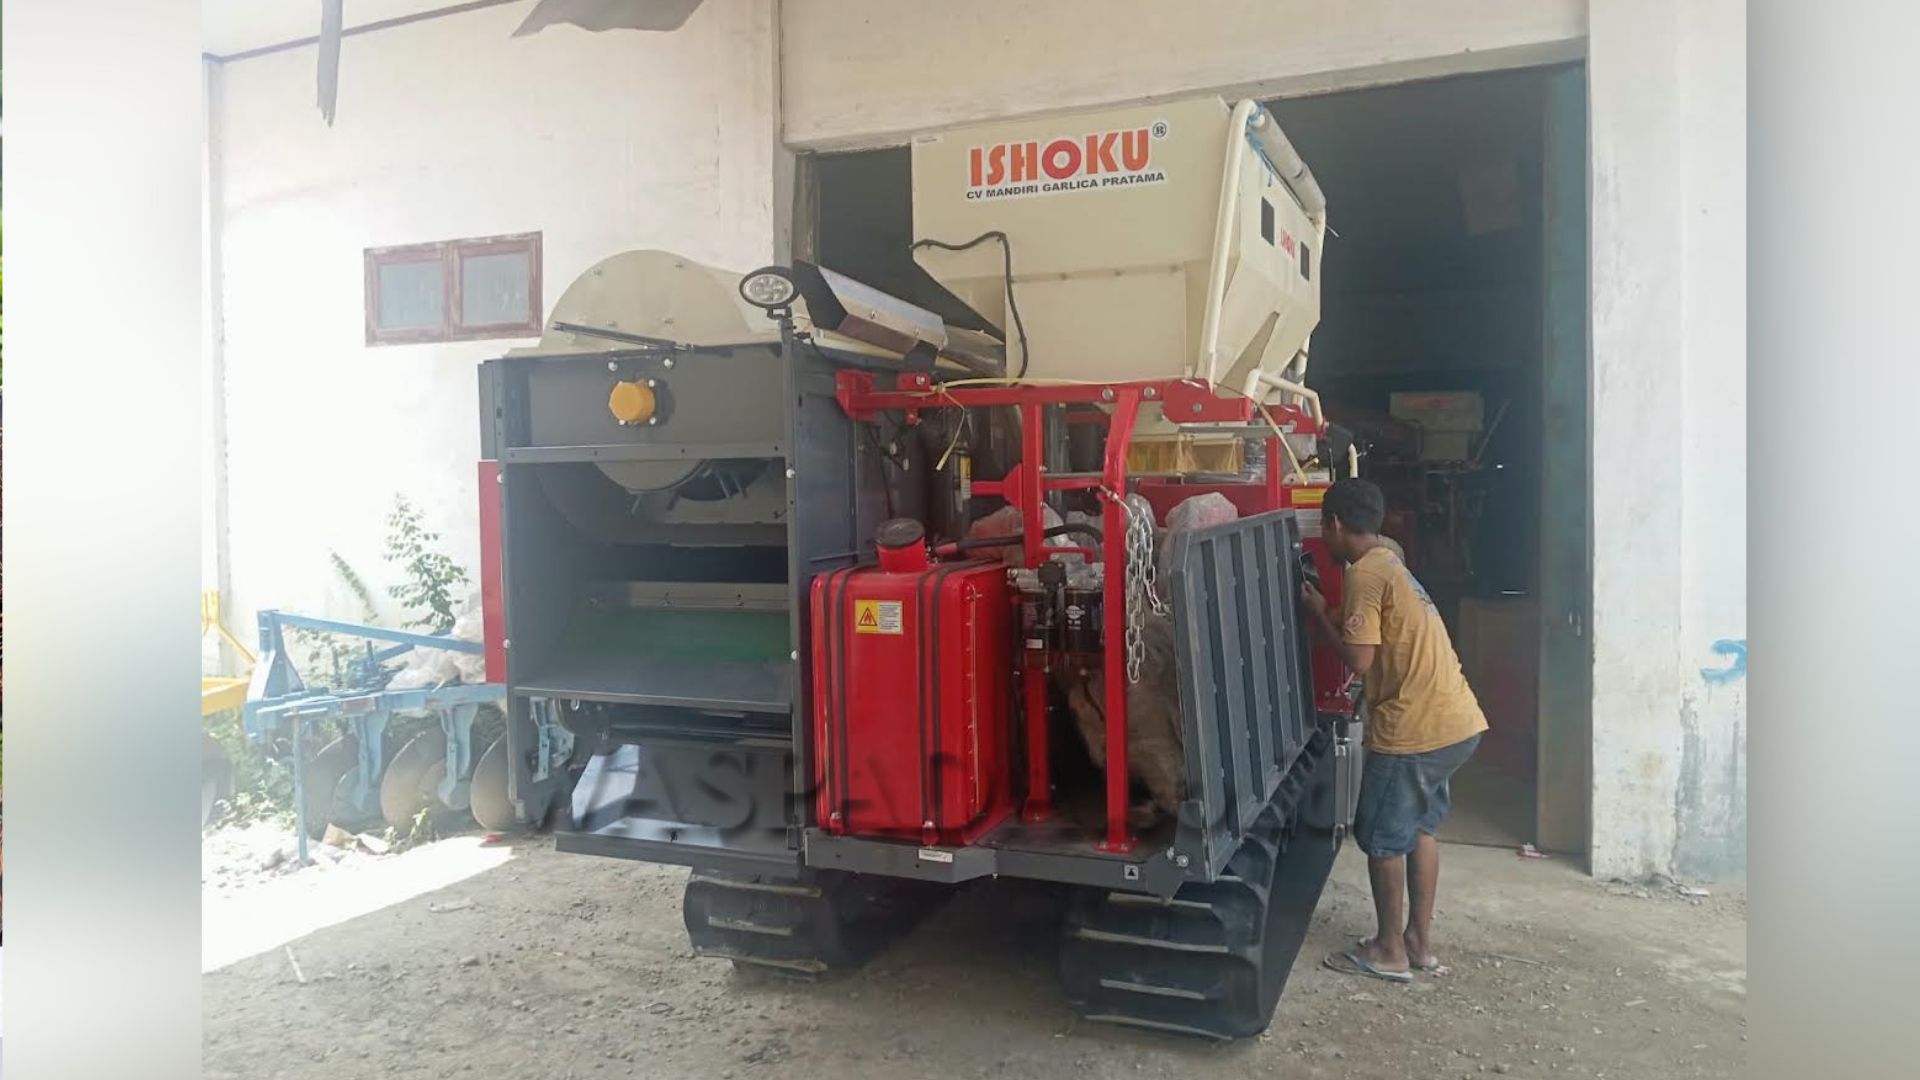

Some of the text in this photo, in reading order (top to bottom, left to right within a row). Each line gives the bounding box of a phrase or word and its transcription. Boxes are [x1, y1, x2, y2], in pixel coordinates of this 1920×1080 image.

[970, 129, 1149, 187] ISHOKU
[966, 172, 1165, 200] CV MANDIRI GARLICA PRATAMA
